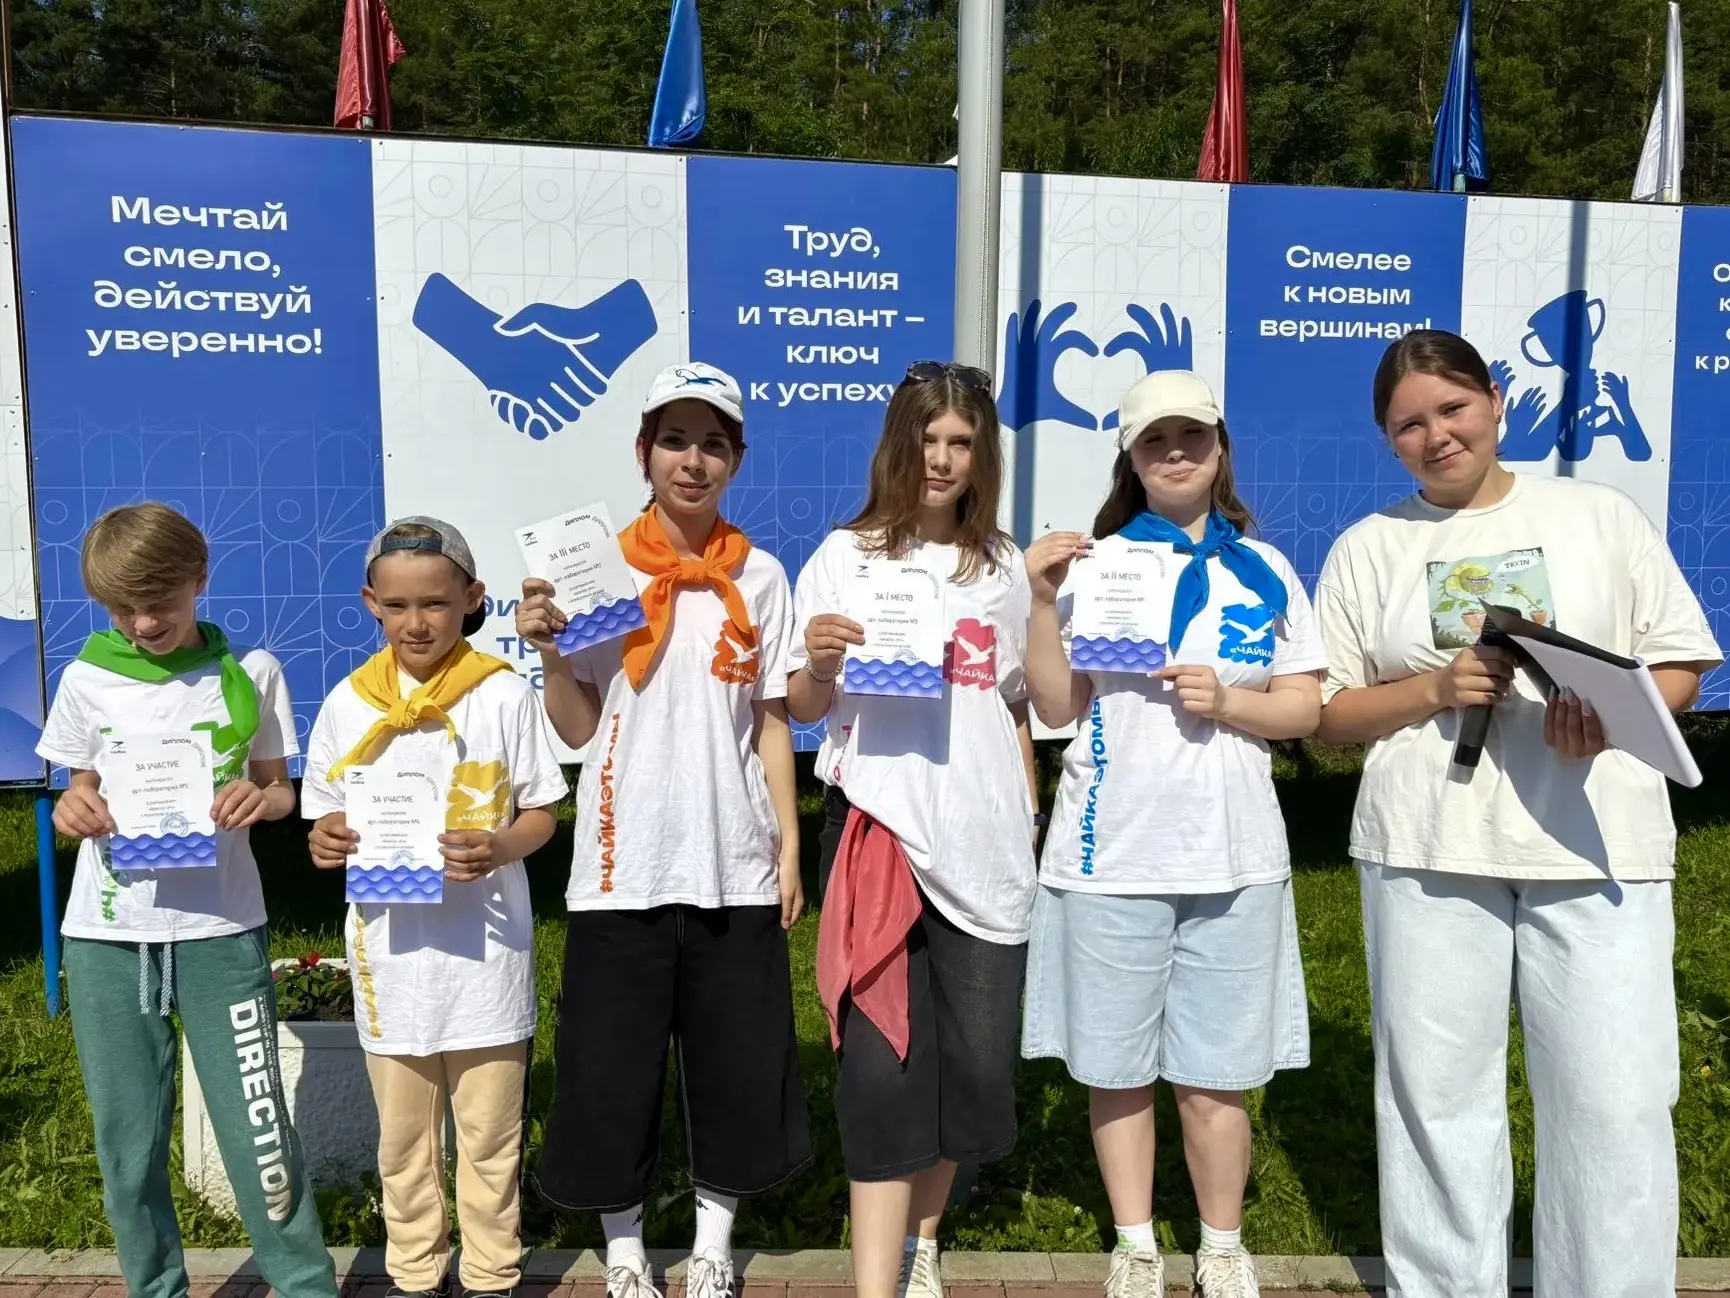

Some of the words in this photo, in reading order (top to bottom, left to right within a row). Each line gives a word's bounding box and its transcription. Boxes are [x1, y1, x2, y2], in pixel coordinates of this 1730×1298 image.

[111, 195, 288, 231] Мечтай
[783, 224, 880, 259] Труд,
[124, 245, 281, 278] смело,
[1286, 245, 1412, 271] Смелее
[764, 268, 899, 291] знания
[93, 280, 312, 320] действуй
[1284, 285, 1301, 303] к
[1308, 286, 1411, 305] новым
[738, 306, 761, 325] и
[768, 306, 898, 328] талант
[85, 328, 323, 358] уверенно!
[786, 345, 879, 365] ключ
[750, 382, 770, 401] к
[548, 552, 559, 561] ЗА
[568, 541, 591, 554] МЕСТО
[1118, 572, 1141, 580] МЕСТО
[875, 592, 884, 600] ЗА
[890, 593, 914, 602] МЕСТО
[135, 763, 146, 772] ЗА
[147, 760, 180, 771] УЧАСТИЕ
[372, 795, 382, 803] ЗА
[383, 795, 414, 803] УЧАСТИЕ
